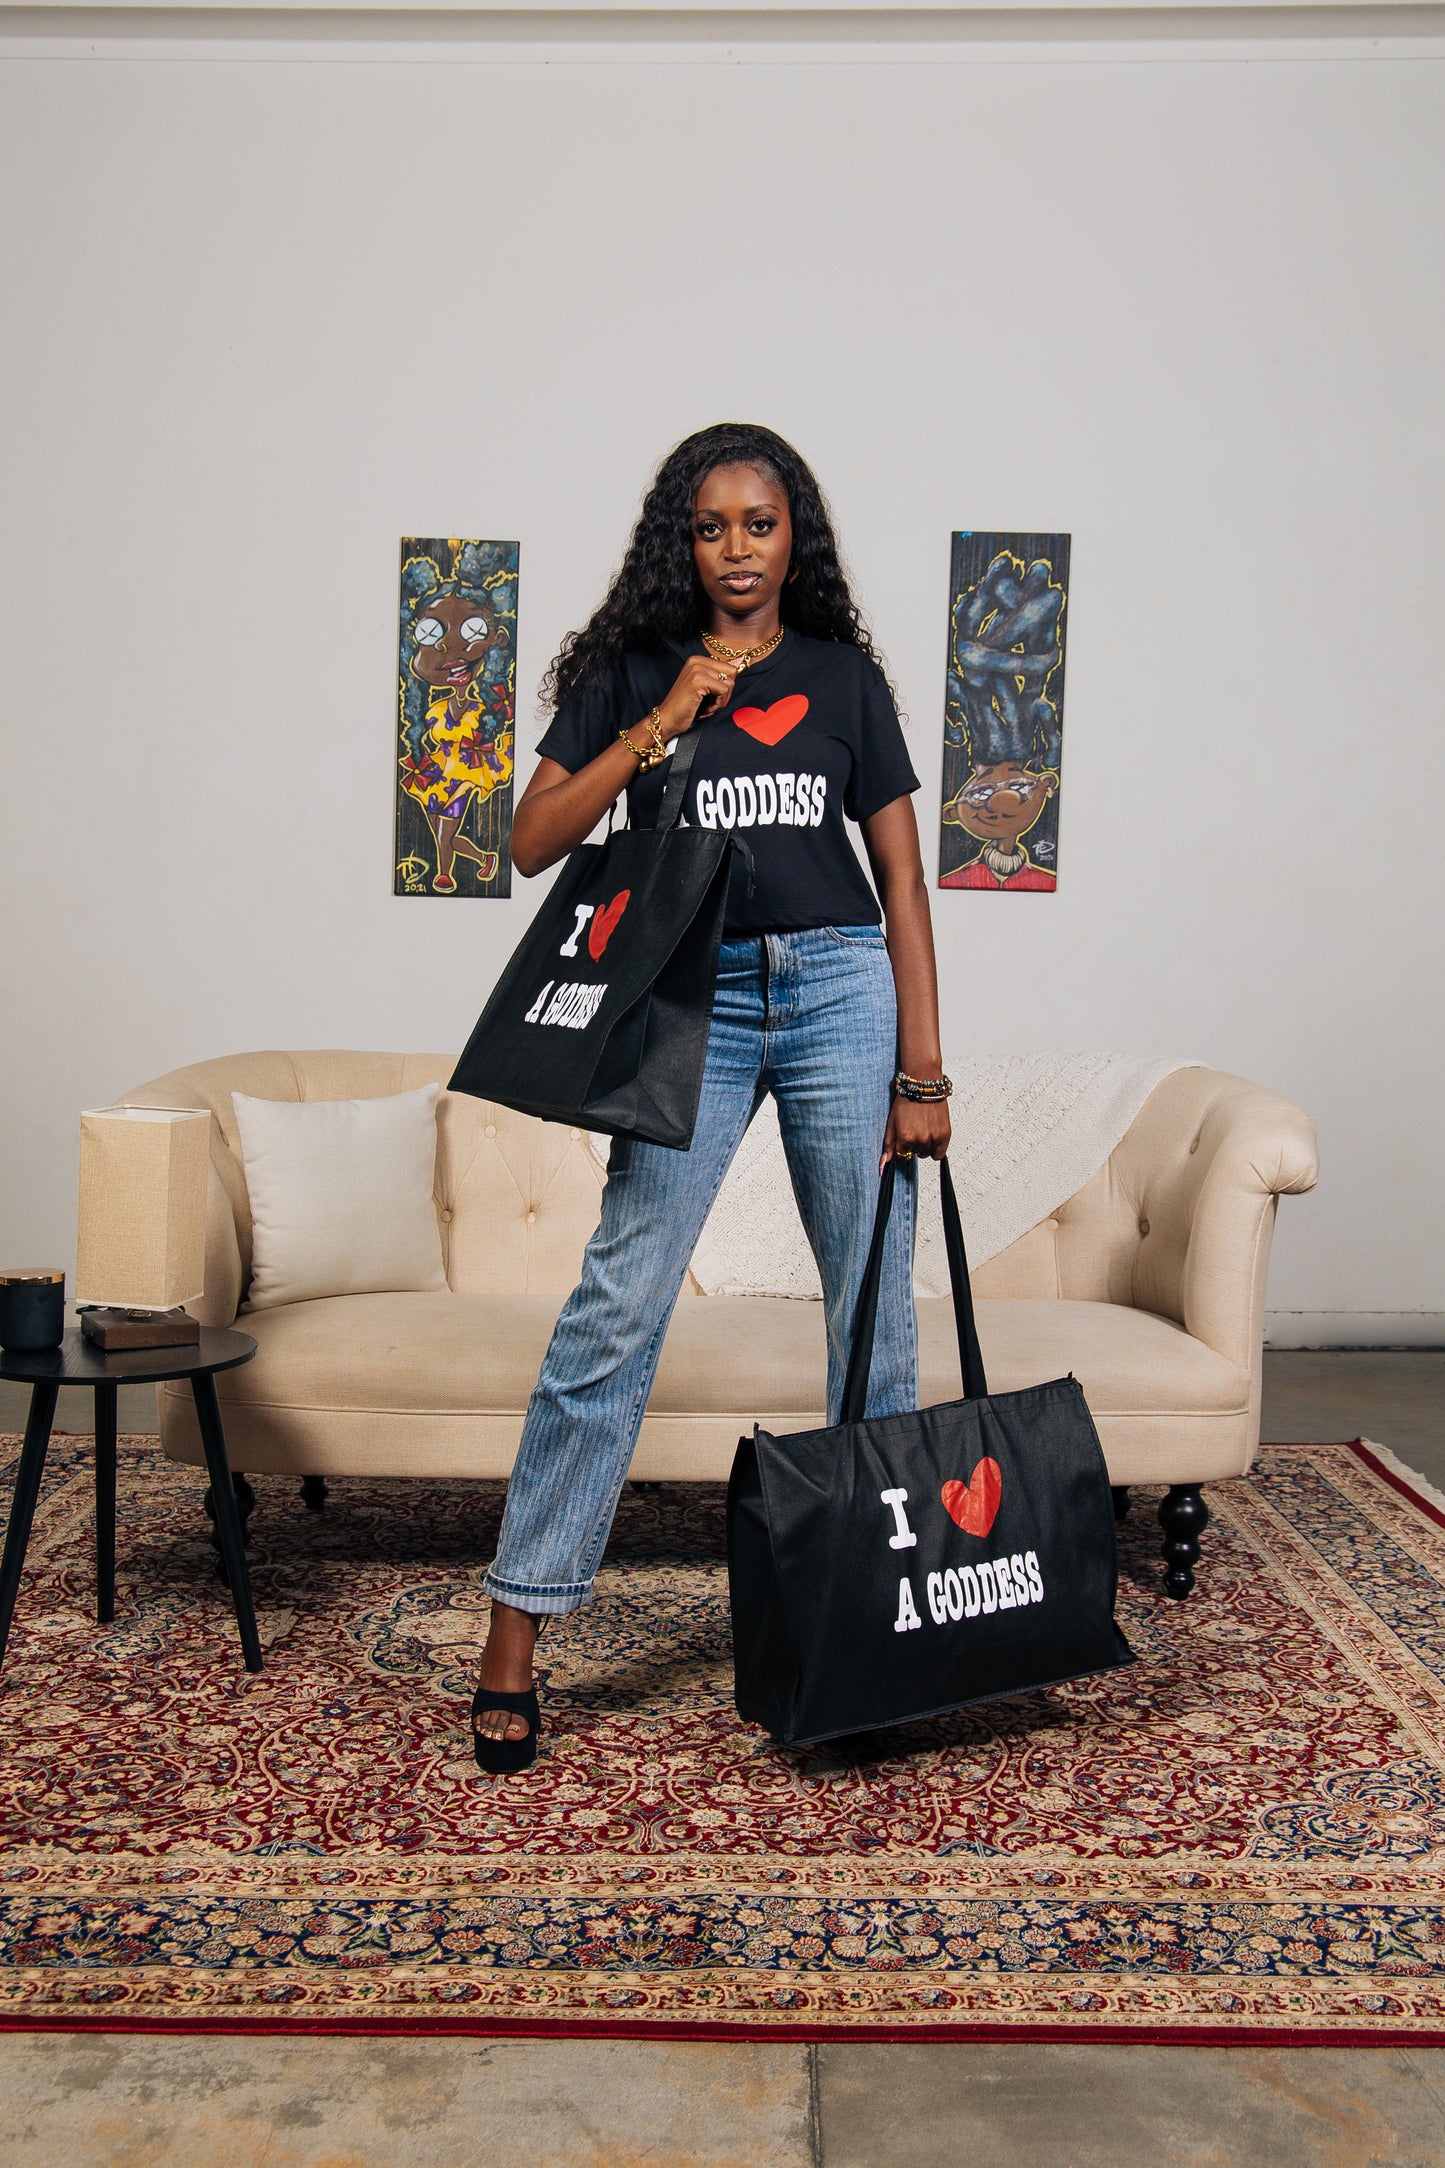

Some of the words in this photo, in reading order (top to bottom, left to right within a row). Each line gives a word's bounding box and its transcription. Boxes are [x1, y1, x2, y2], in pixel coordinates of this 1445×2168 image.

[696, 773, 827, 829] GODDESS
[404, 883, 427, 892] 2021
[560, 904, 594, 957] I
[525, 980, 555, 1024] A
[881, 1488, 917, 1549] I
[894, 1577, 922, 1632] A
[927, 1551, 1044, 1625] GODDESS
